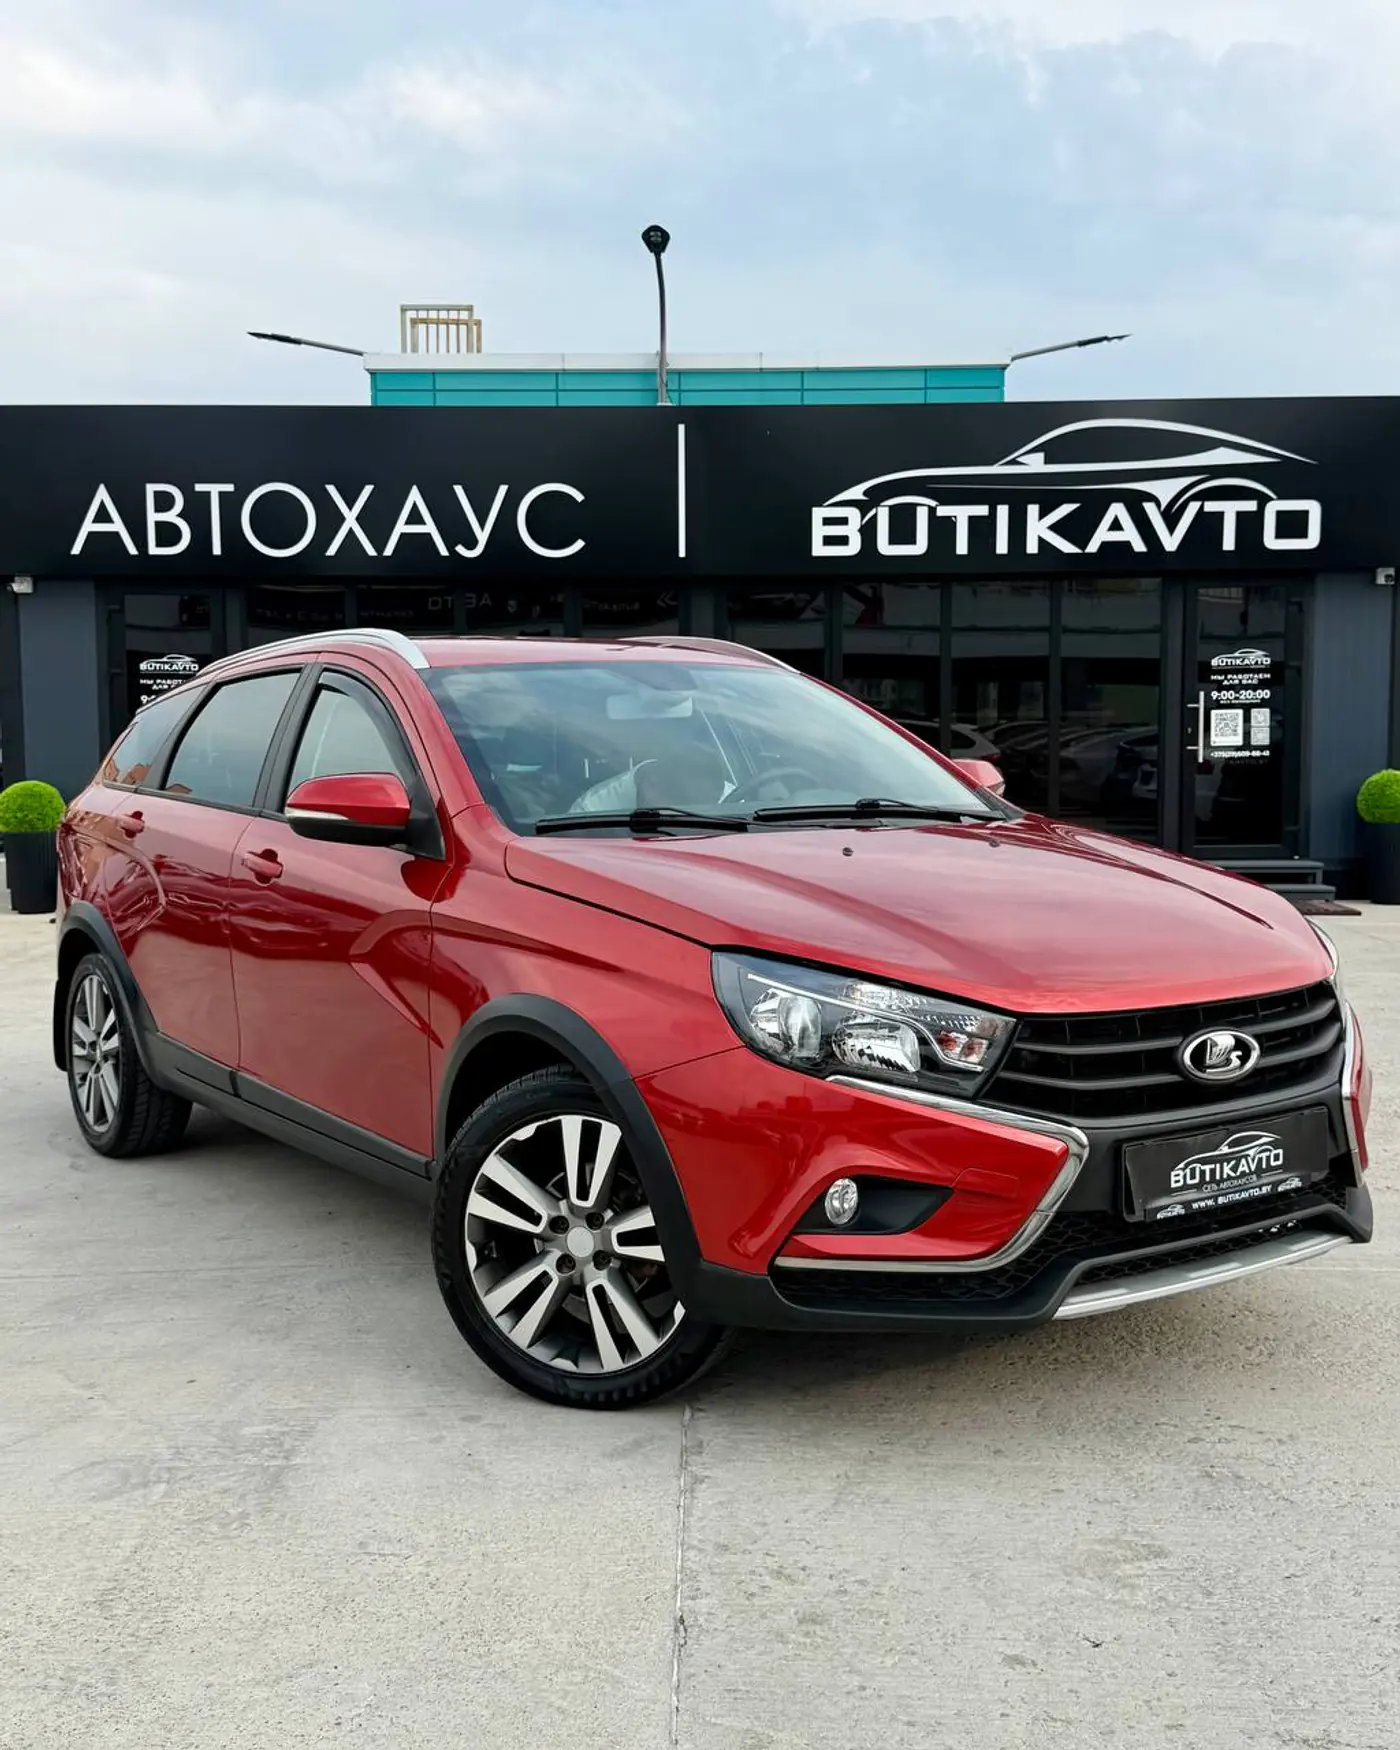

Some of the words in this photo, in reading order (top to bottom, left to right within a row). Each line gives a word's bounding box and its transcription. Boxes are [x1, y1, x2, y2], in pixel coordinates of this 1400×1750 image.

[70, 481, 586, 558] АВТОХАУС
[811, 498, 1322, 557] BUTIKAVTO
[139, 663, 199, 671] BUTIKAVTO
[1210, 658, 1271, 666] BUTIKAVTO
[1211, 689, 1270, 700] 9:00-20:00
[1170, 1149, 1283, 1188] BUTIKAVTO
[1202, 1184, 1218, 1193] СЕТЬ
